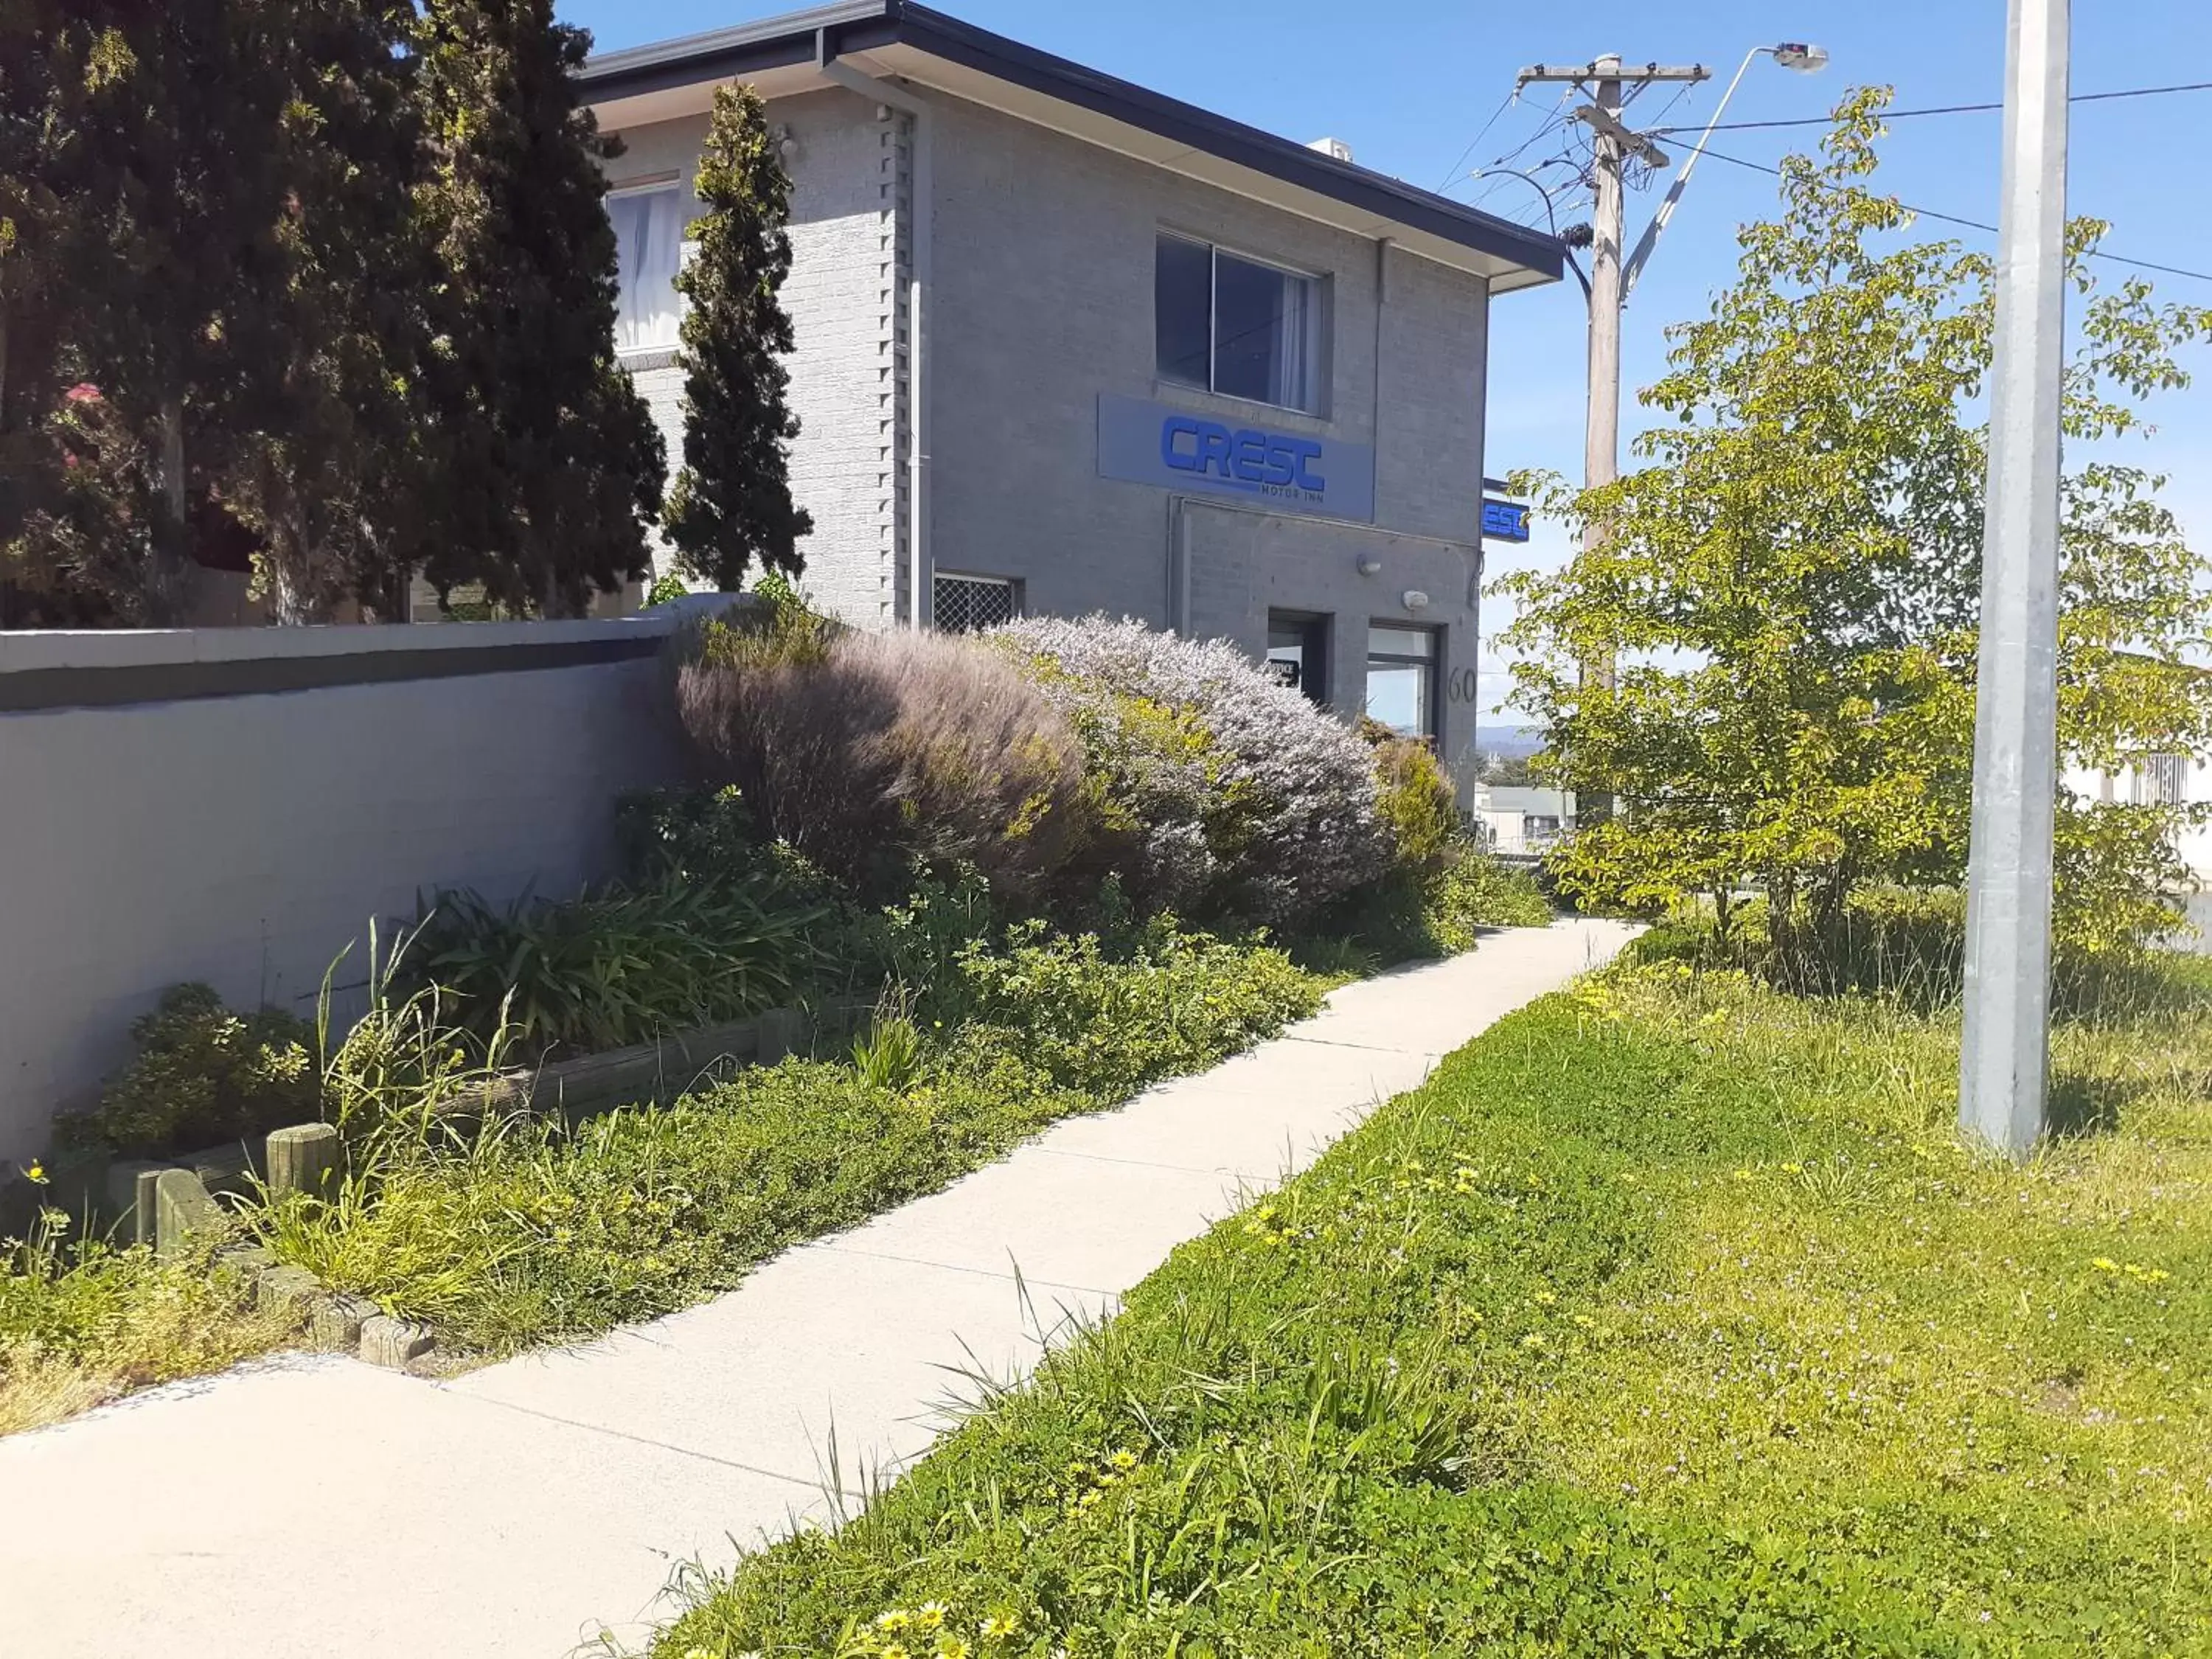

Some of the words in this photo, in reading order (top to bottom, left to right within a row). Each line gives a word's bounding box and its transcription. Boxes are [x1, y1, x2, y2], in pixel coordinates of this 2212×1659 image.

[1161, 416, 1325, 492] CREST
[1262, 484, 1299, 499] MOTOR
[1304, 491, 1324, 503] INN
[1448, 666, 1477, 703] 60
